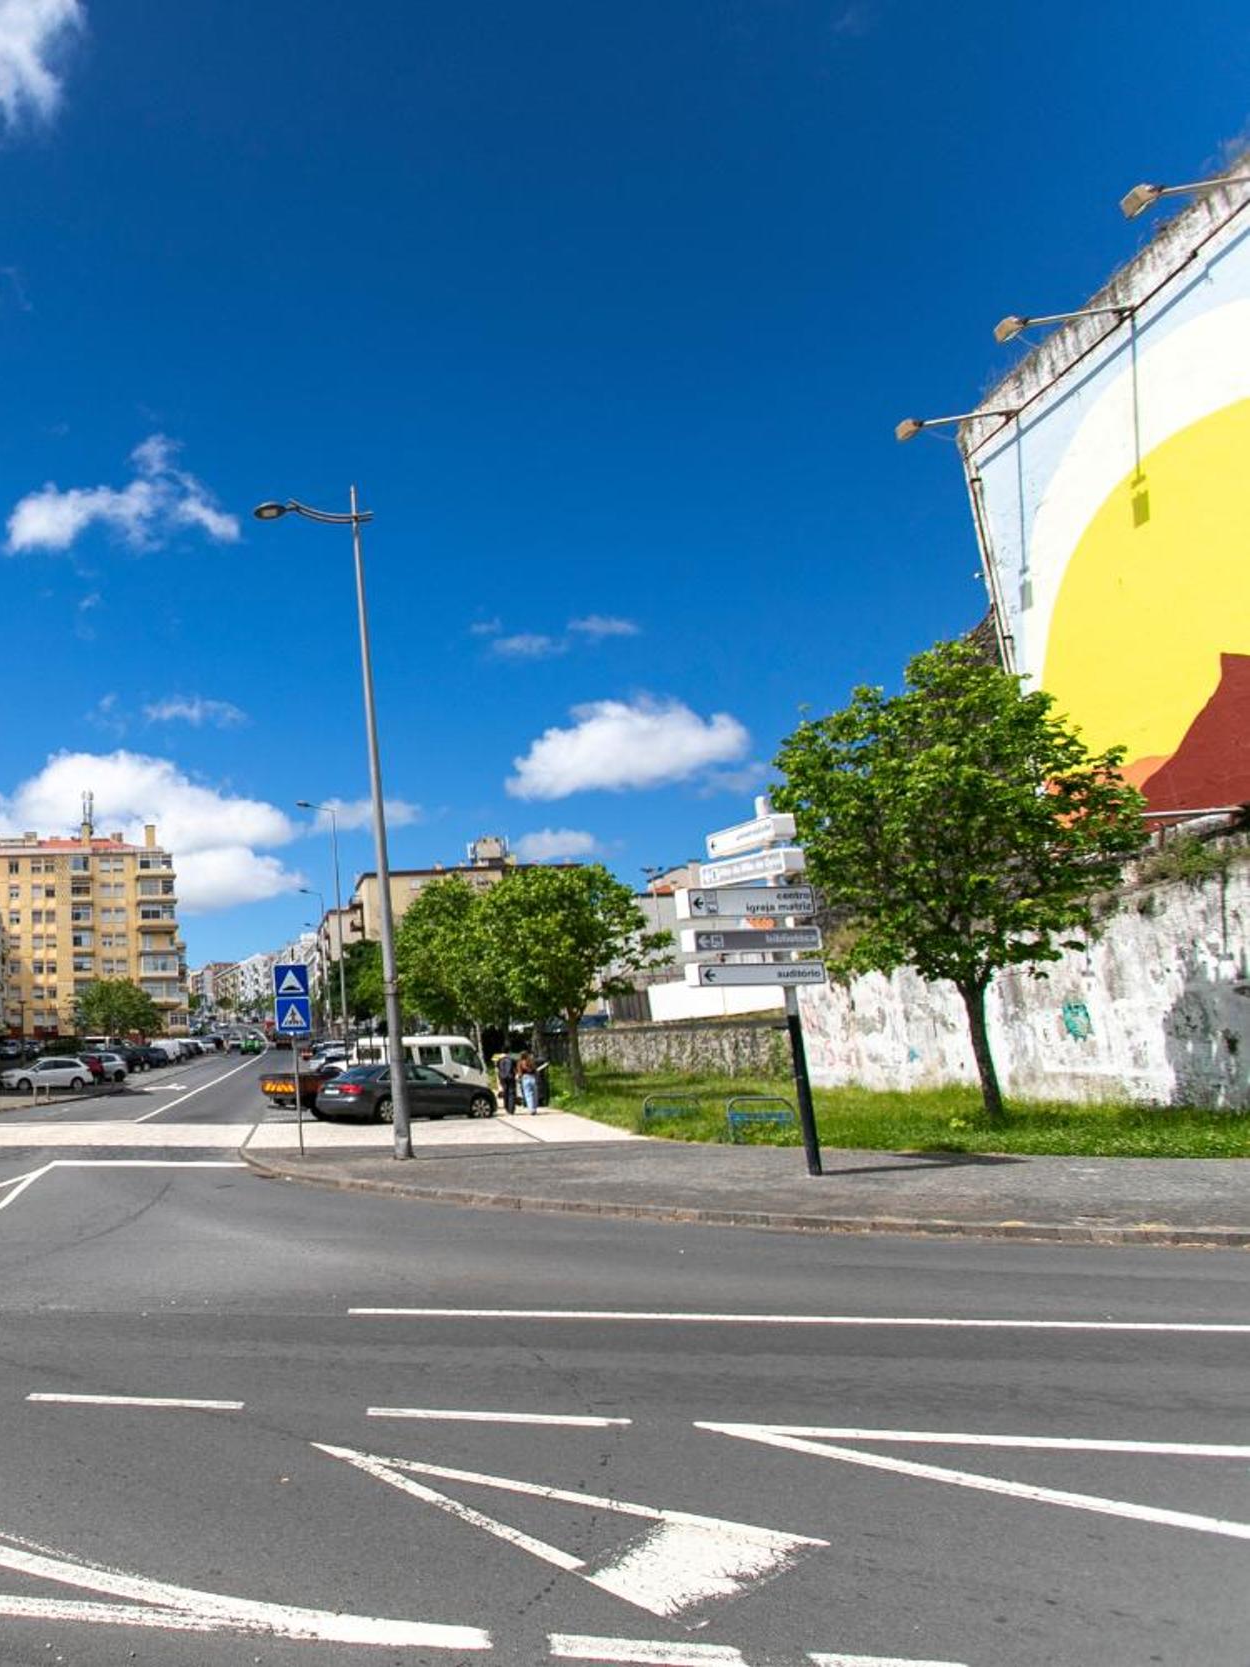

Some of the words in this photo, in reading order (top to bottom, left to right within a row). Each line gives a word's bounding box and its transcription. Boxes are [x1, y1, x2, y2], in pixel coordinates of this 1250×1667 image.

[776, 892, 811, 900] centro
[746, 902, 776, 914] igreja
[778, 902, 812, 911] matriz
[765, 932, 817, 943] biblioteca
